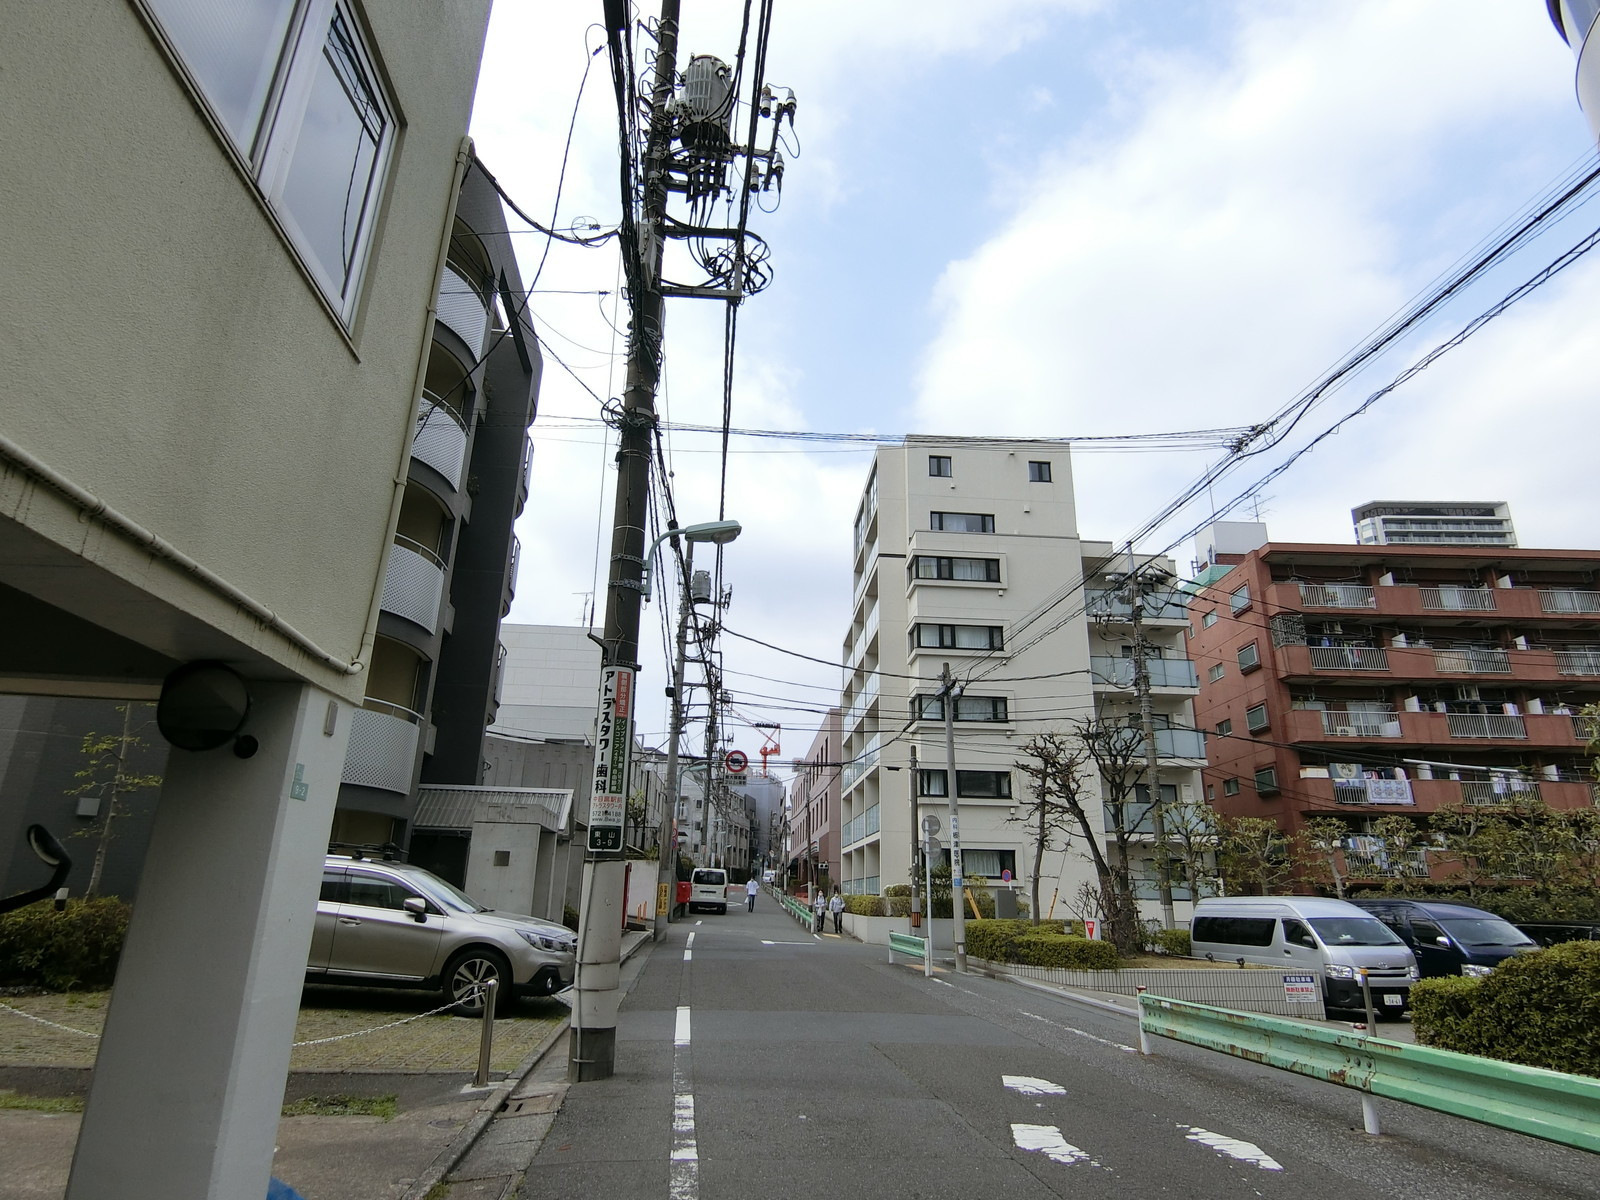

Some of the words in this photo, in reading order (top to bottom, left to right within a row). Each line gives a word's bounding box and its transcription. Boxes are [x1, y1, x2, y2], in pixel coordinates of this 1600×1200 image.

[595, 671, 615, 793] アトラスタワー歯科
